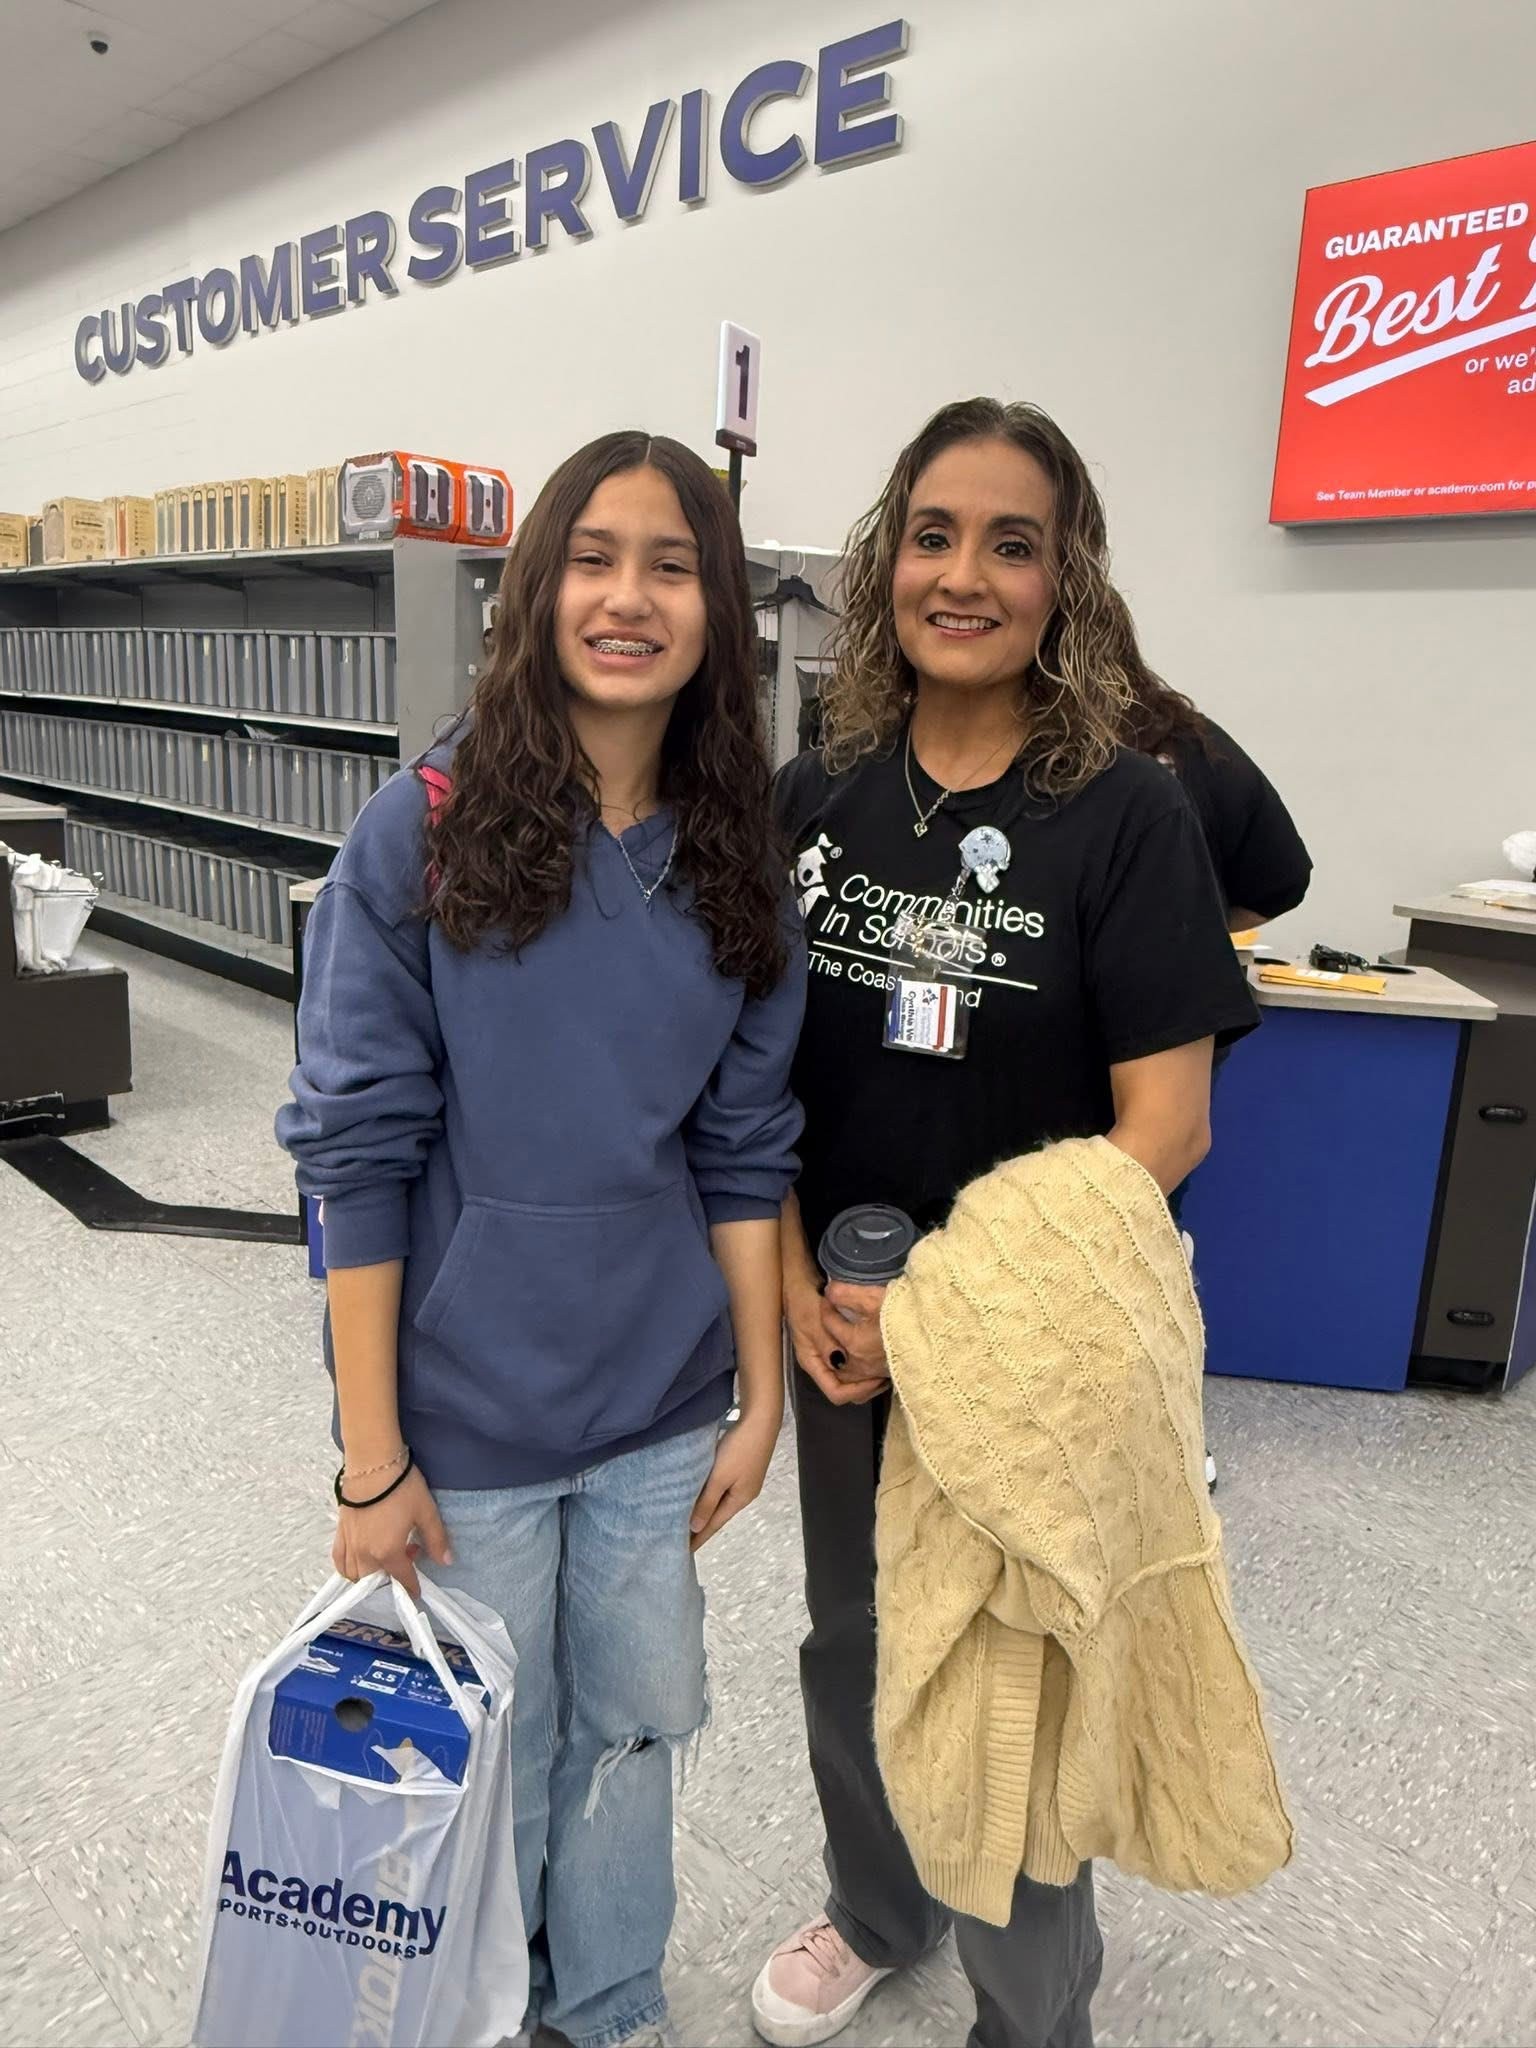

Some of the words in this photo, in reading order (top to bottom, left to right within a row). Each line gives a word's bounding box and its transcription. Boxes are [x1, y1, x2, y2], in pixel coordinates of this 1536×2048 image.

[74, 211, 400, 385] CUSTOMER
[407, 18, 909, 284] SERVICE
[1325, 202, 1529, 260] GUARANTEED
[1304, 243, 1503, 368] Best
[736, 344, 750, 421] 1
[1465, 357, 1489, 374] or
[1495, 346, 1536, 371] we'
[1316, 490, 1335, 501] See
[1338, 488, 1365, 500] Team
[1368, 486, 1412, 498] Member
[1414, 487, 1424, 496] or
[1428, 481, 1505, 496] academy.com
[1508, 479, 1526, 490] for
[819, 904, 850, 936] In
[808, 951, 842, 977] The
[372, 1670, 398, 1683] 6.5
[219, 1898, 417, 1961] PORTS+OUTDOORS
[220, 1850, 447, 1956] Academy
